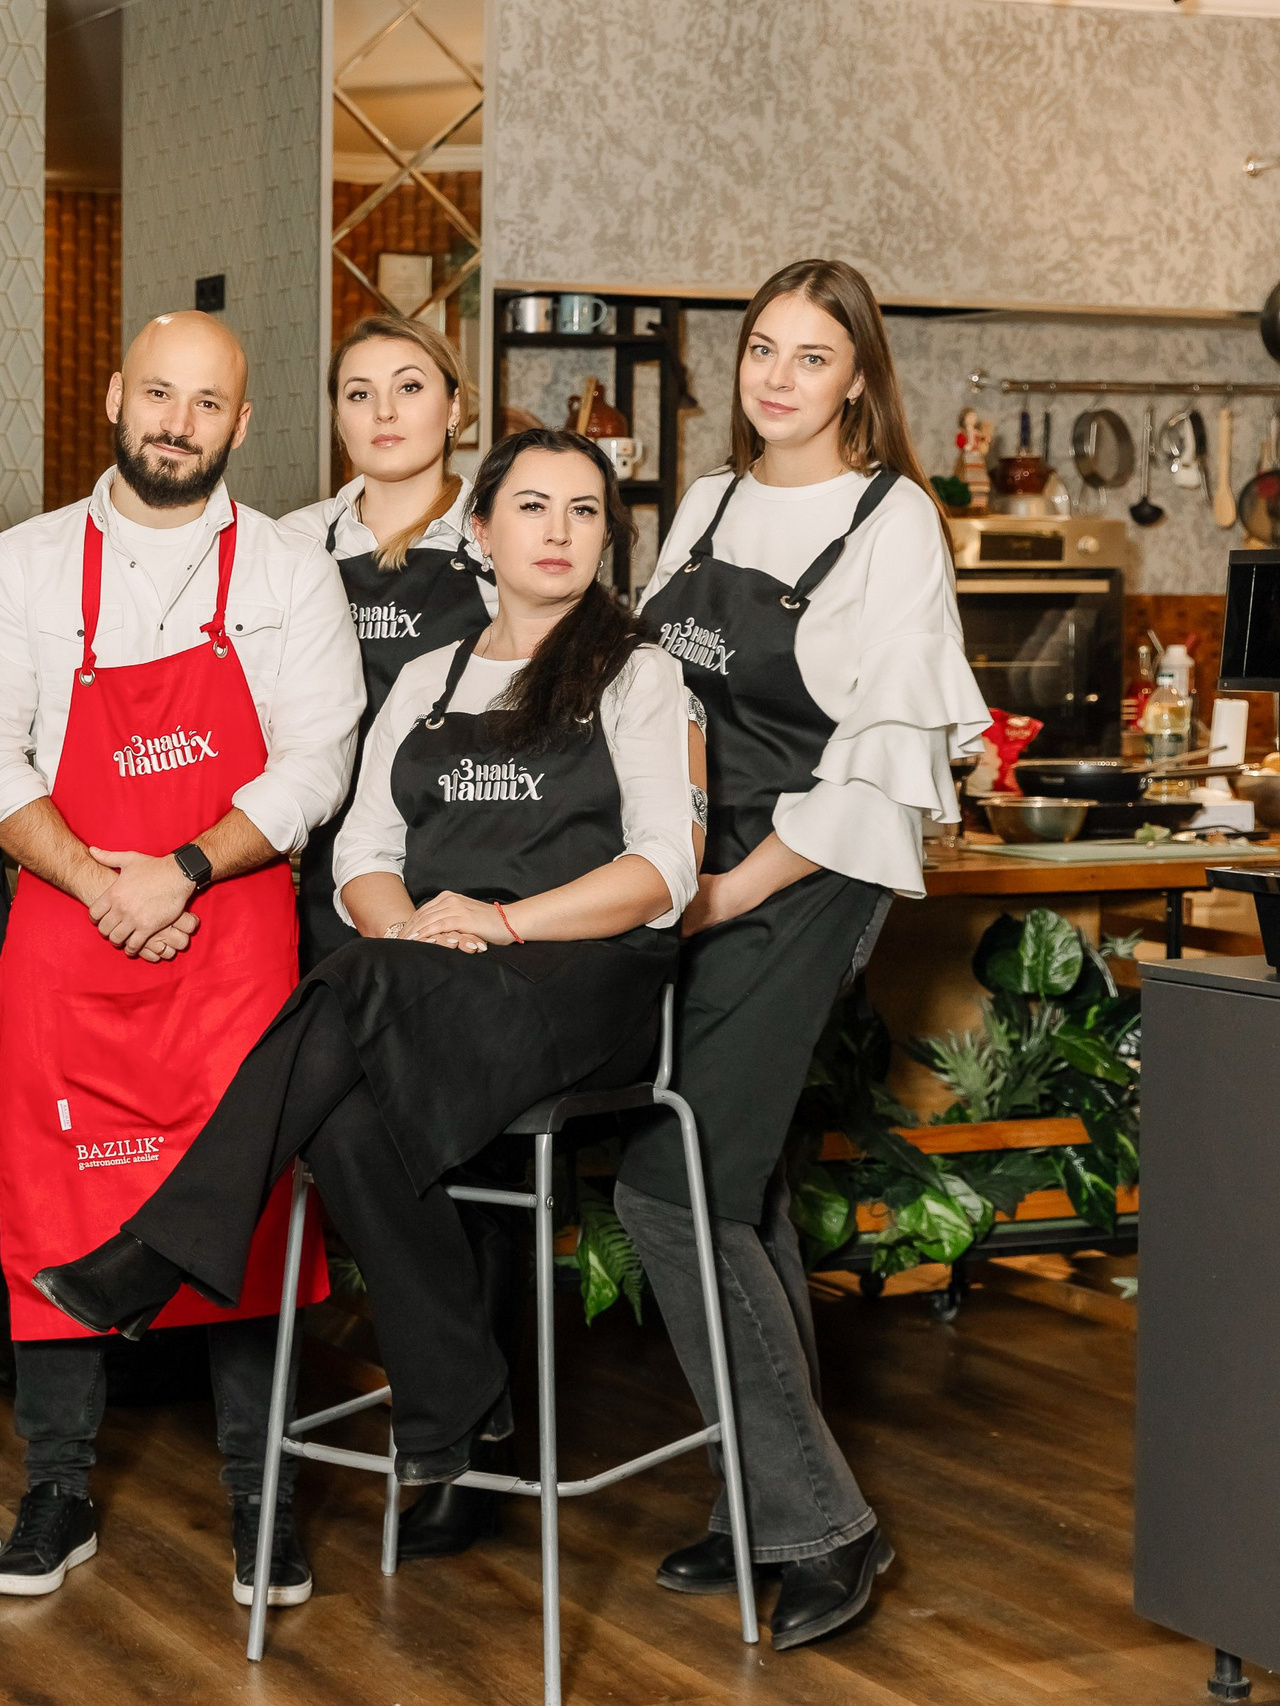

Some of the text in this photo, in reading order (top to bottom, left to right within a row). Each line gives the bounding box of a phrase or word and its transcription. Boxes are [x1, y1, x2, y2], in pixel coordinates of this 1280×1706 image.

[673, 617, 721, 650] Знай
[124, 725, 190, 756] Знай
[452, 757, 519, 781] Знай
[78, 1153, 160, 1171] gastronomic atelier
